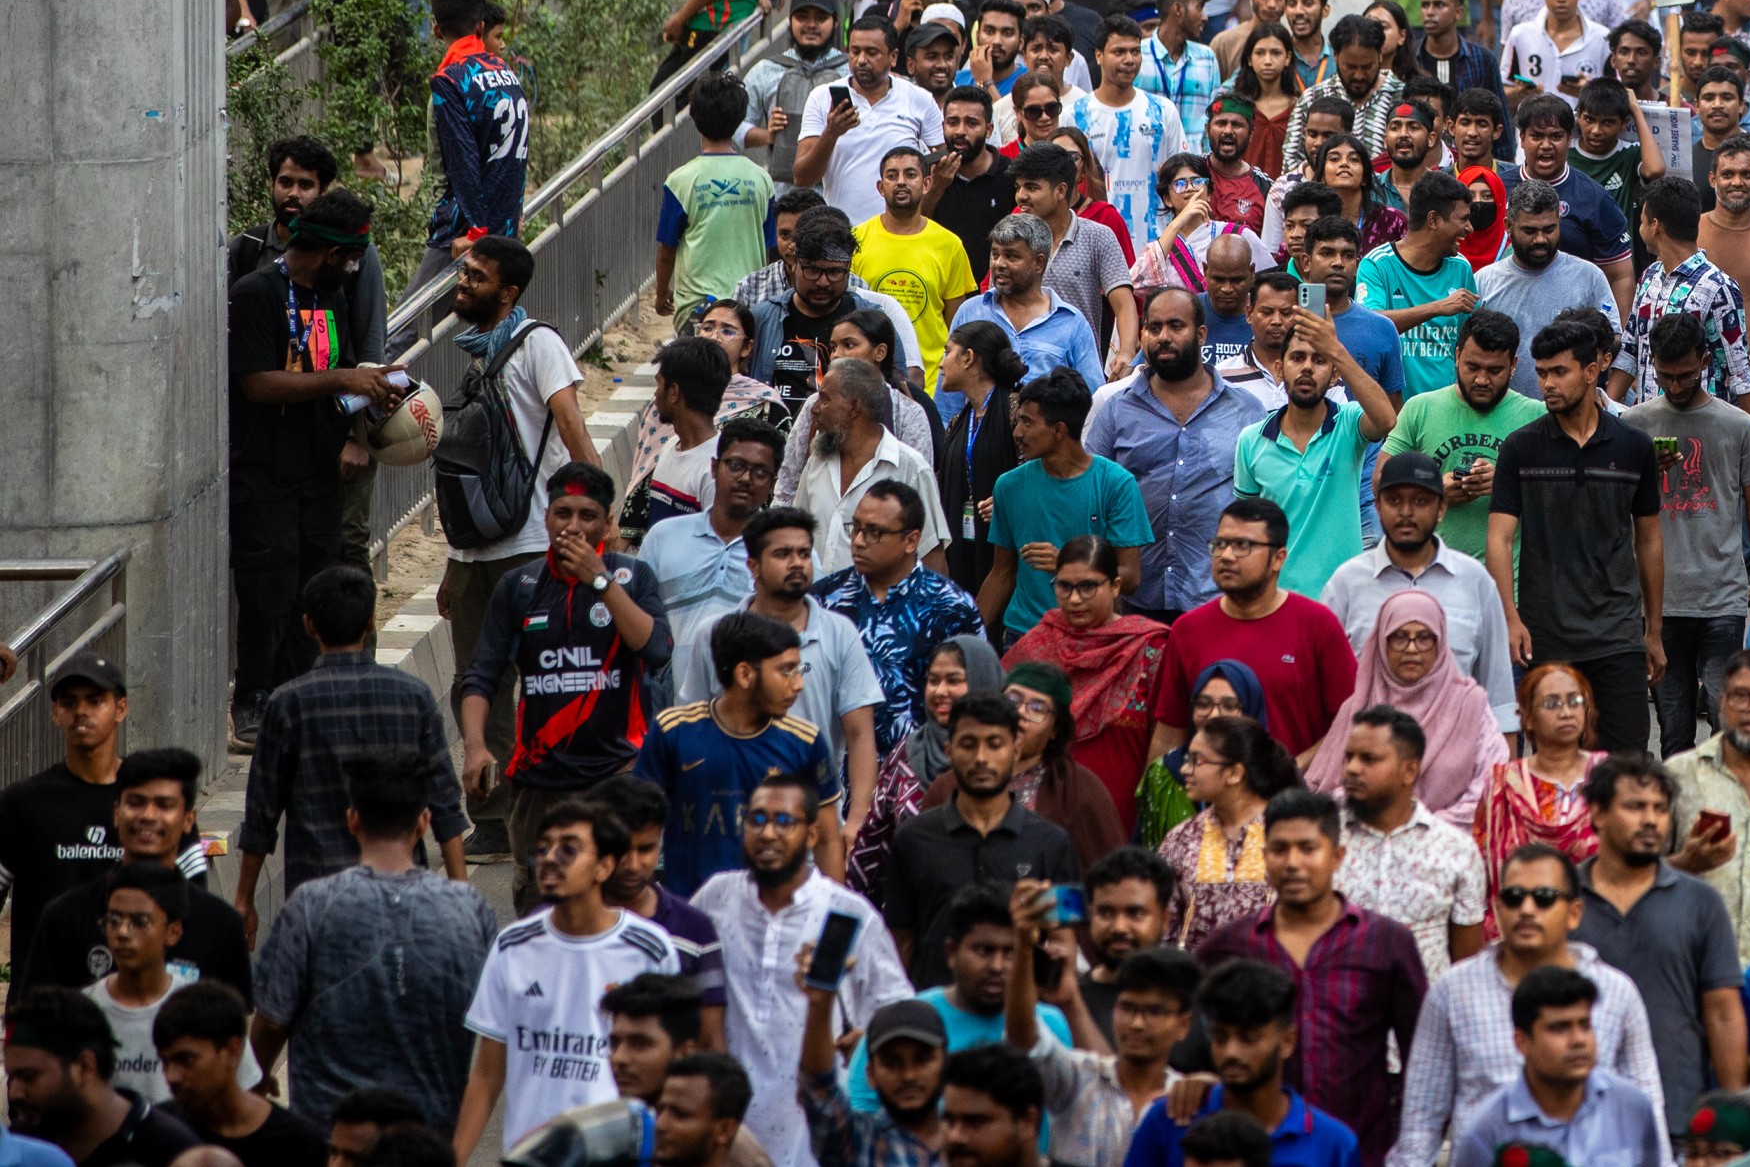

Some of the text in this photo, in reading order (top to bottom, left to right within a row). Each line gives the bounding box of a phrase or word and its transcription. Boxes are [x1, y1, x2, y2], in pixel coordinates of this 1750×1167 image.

[1528, 54, 1542, 77] 3
[486, 97, 530, 161] 32
[1400, 323, 1458, 341] mirates
[1215, 343, 1241, 354] HOLY
[539, 646, 603, 670] CIVIL
[57, 844, 125, 862] balenciag
[516, 1025, 608, 1058] Emirate
[114, 1053, 159, 1074] onder
[550, 1055, 601, 1082] BETTER
